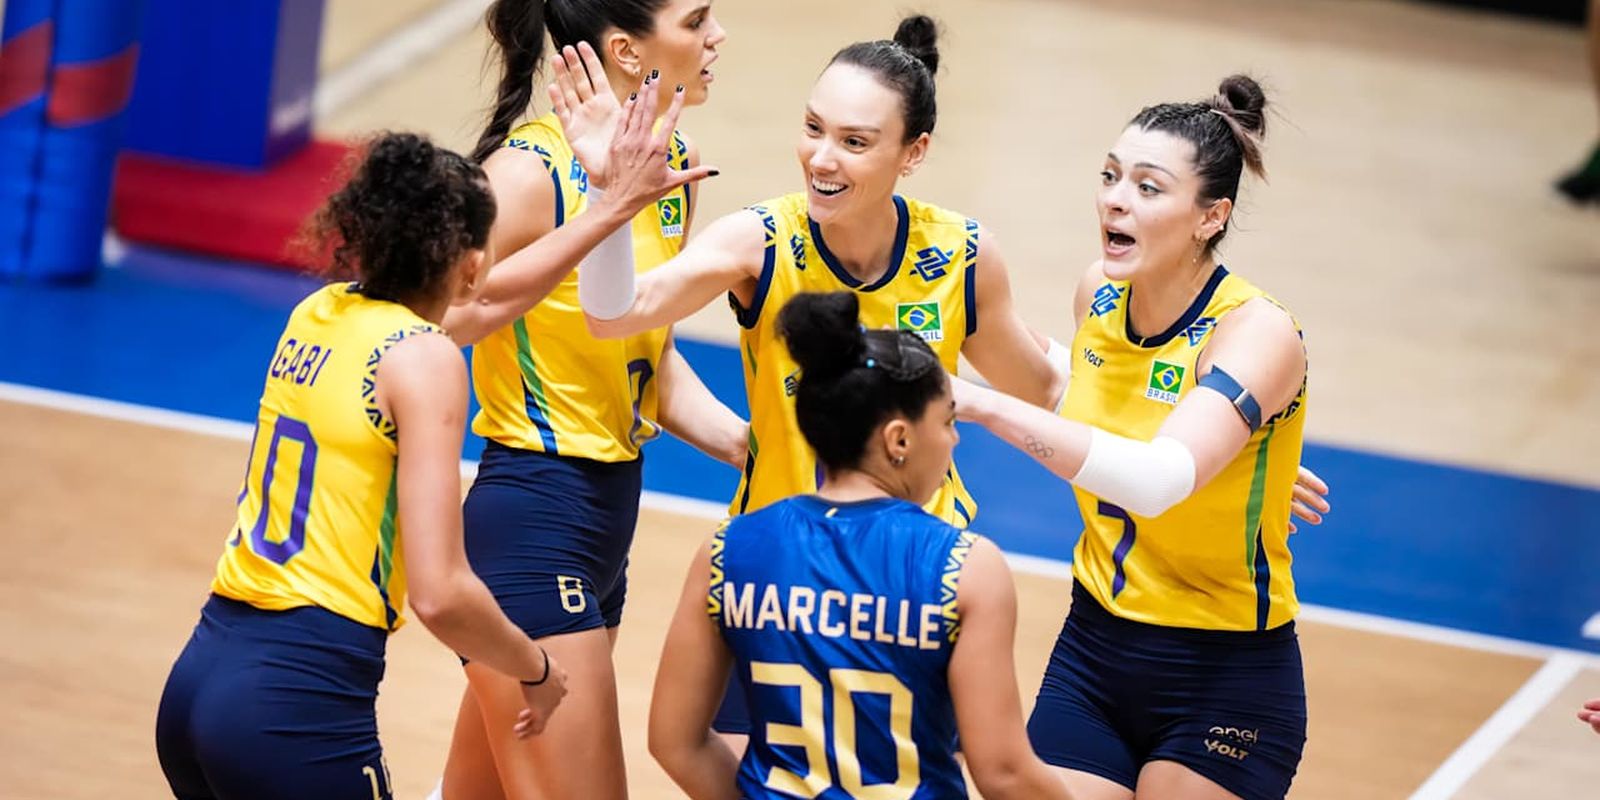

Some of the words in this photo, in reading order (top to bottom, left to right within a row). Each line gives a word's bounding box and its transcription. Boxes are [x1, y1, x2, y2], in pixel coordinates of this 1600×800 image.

[271, 338, 332, 387] GABI
[1146, 388, 1178, 403] BRASIL
[229, 413, 319, 566] 0
[1097, 498, 1137, 600] 7
[556, 575, 587, 614] 8
[723, 581, 943, 651] MARCELLE
[750, 660, 921, 800] 30
[1204, 738, 1249, 760] VOLT
